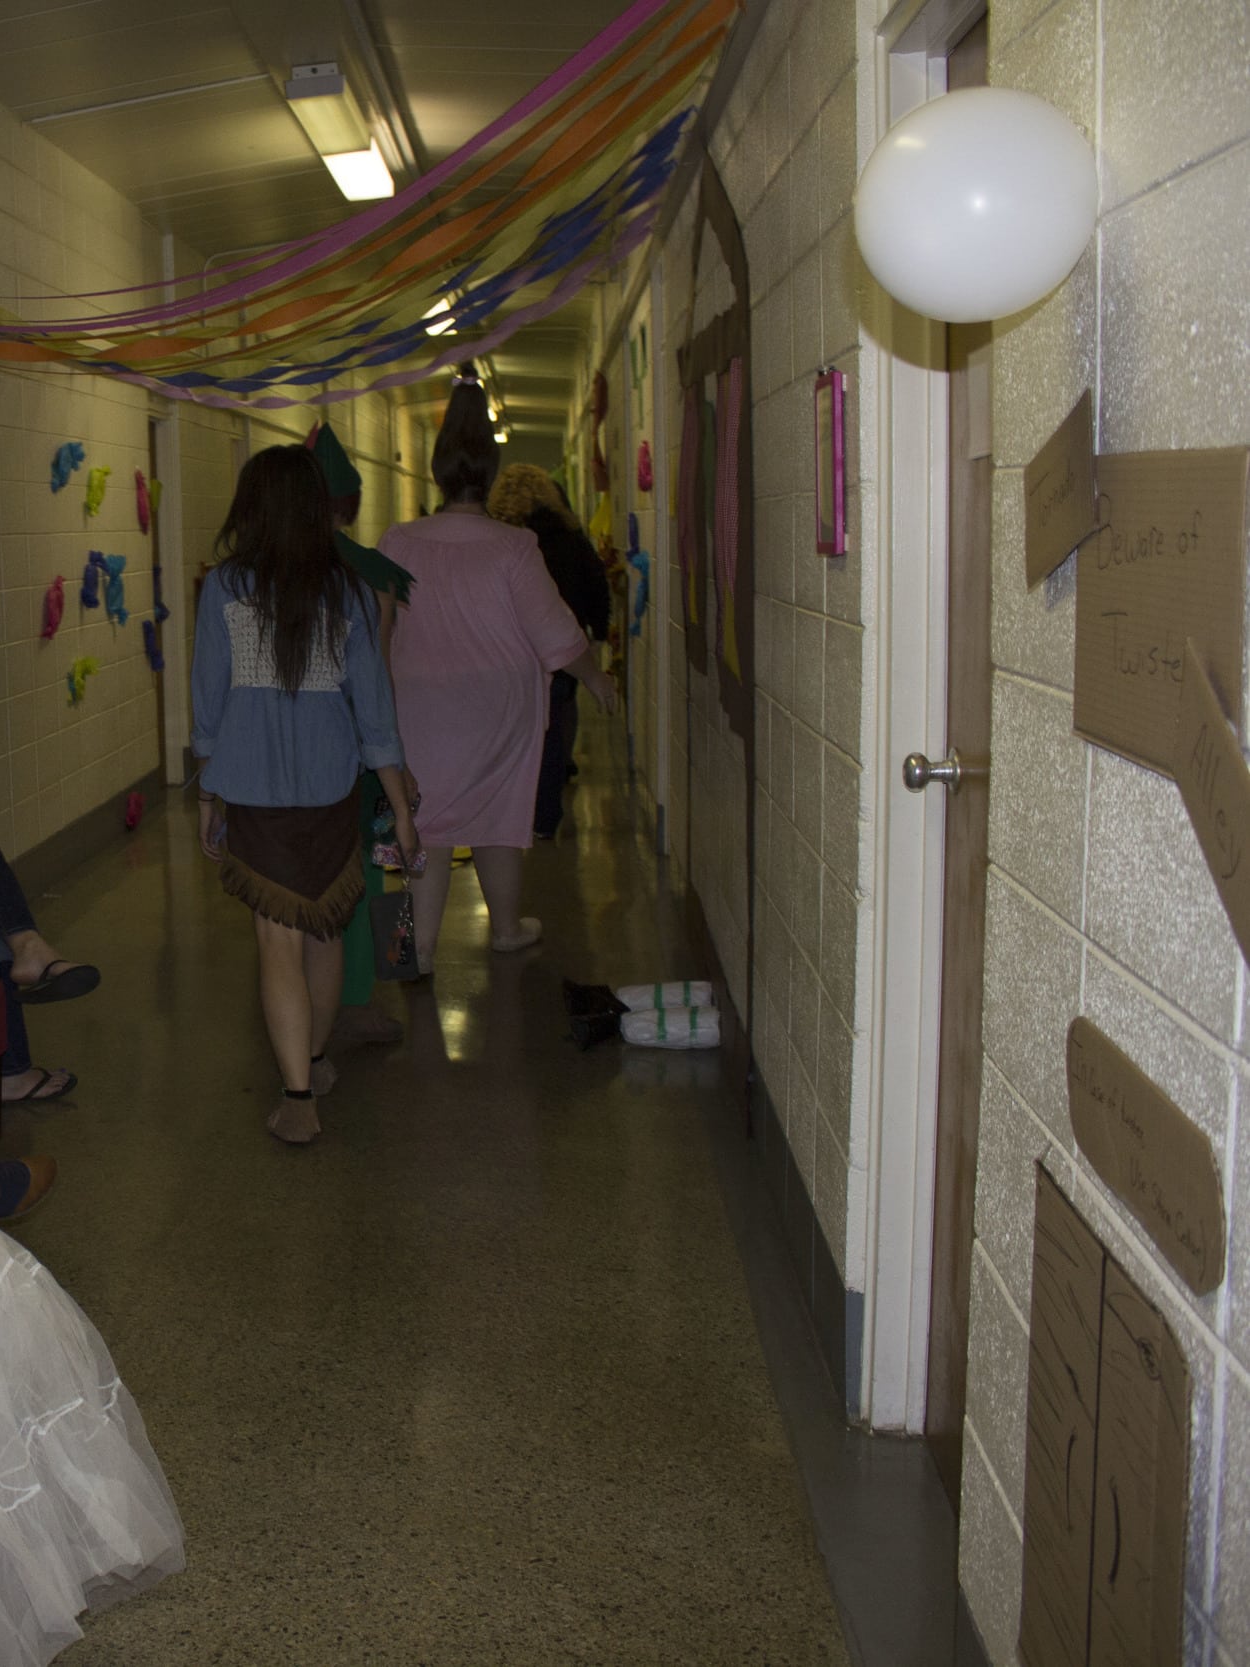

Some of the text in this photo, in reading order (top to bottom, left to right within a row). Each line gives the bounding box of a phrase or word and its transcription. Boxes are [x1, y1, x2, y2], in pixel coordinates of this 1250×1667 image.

[1097, 492, 1203, 571] Beware of
[1101, 611, 1186, 684] Twiste
